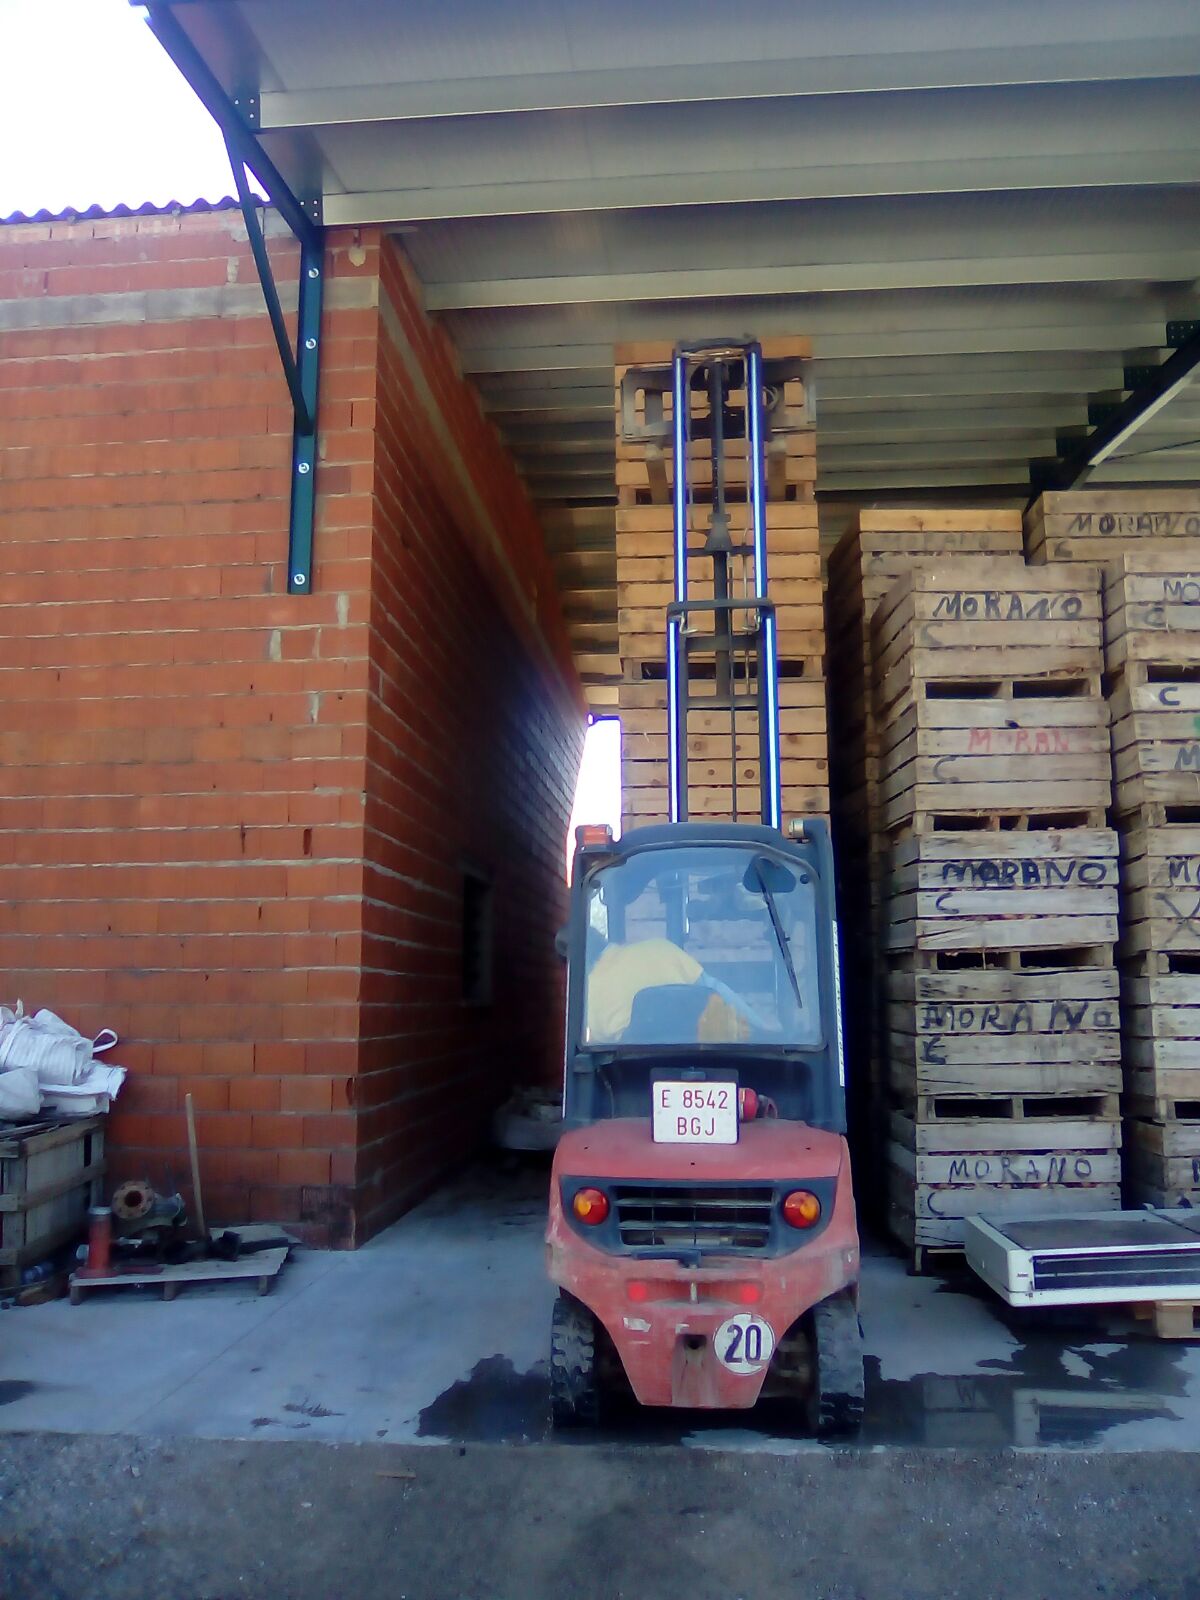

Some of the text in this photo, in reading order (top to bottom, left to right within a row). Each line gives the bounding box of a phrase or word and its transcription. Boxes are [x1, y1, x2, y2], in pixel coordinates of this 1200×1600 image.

[932, 592, 1083, 620] MORANO
[1158, 686, 1181, 706] C
[942, 859, 1108, 885] MORANO
[661, 1089, 728, 1110] E 8542
[677, 1116, 715, 1136] BGJ
[949, 1157, 1092, 1184] MORANO
[724, 1324, 762, 1364] 20
